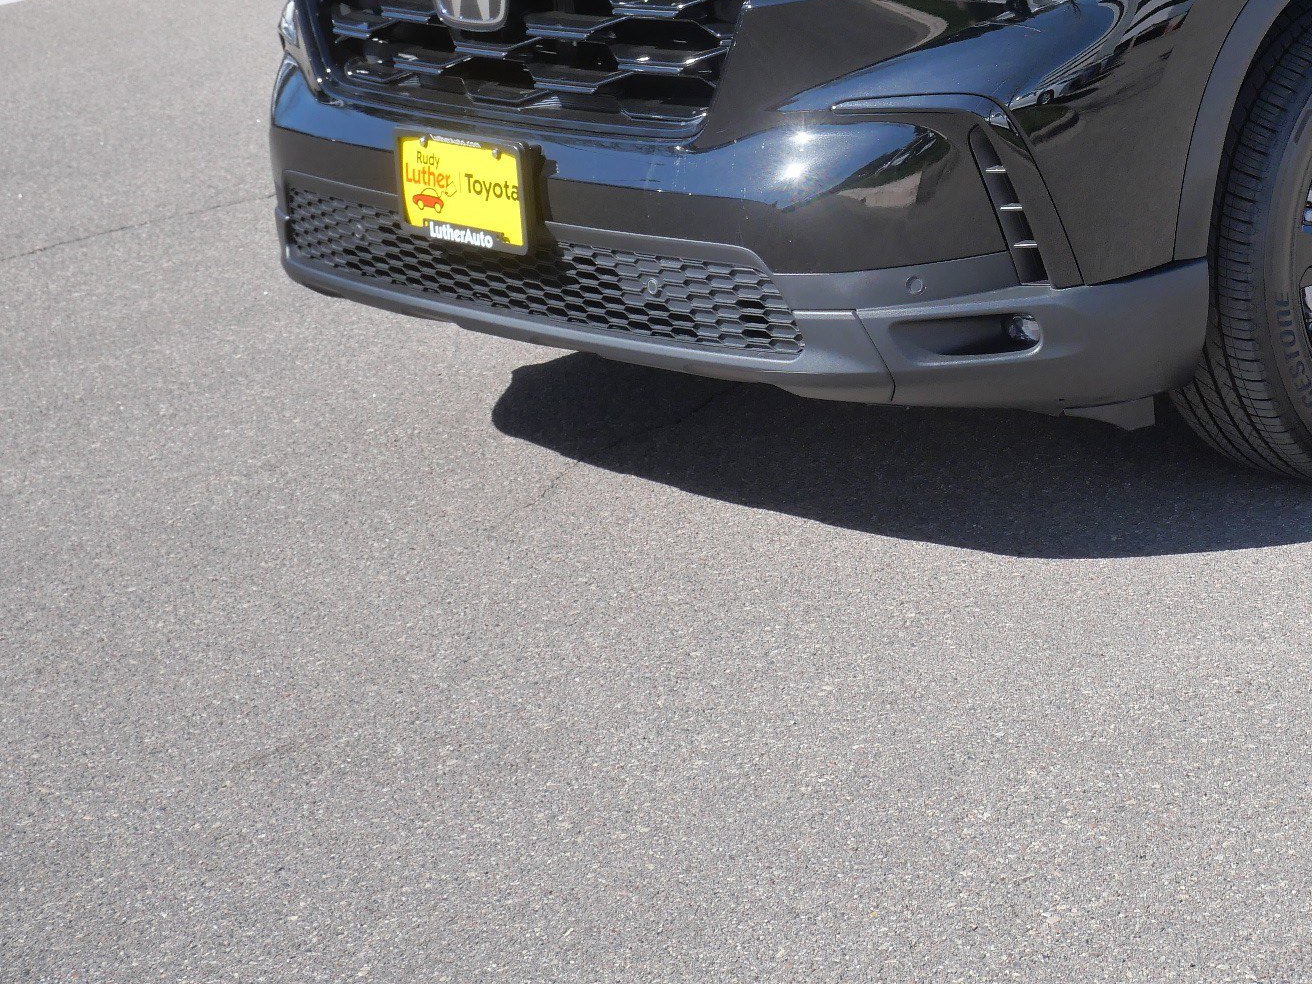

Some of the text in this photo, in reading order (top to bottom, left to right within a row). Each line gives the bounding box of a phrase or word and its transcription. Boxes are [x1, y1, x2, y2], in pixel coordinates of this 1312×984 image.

[416, 151, 440, 170] Rudy
[405, 163, 451, 189] Luther
[464, 173, 520, 202] Toyota
[429, 221, 494, 249] LutherAuto
